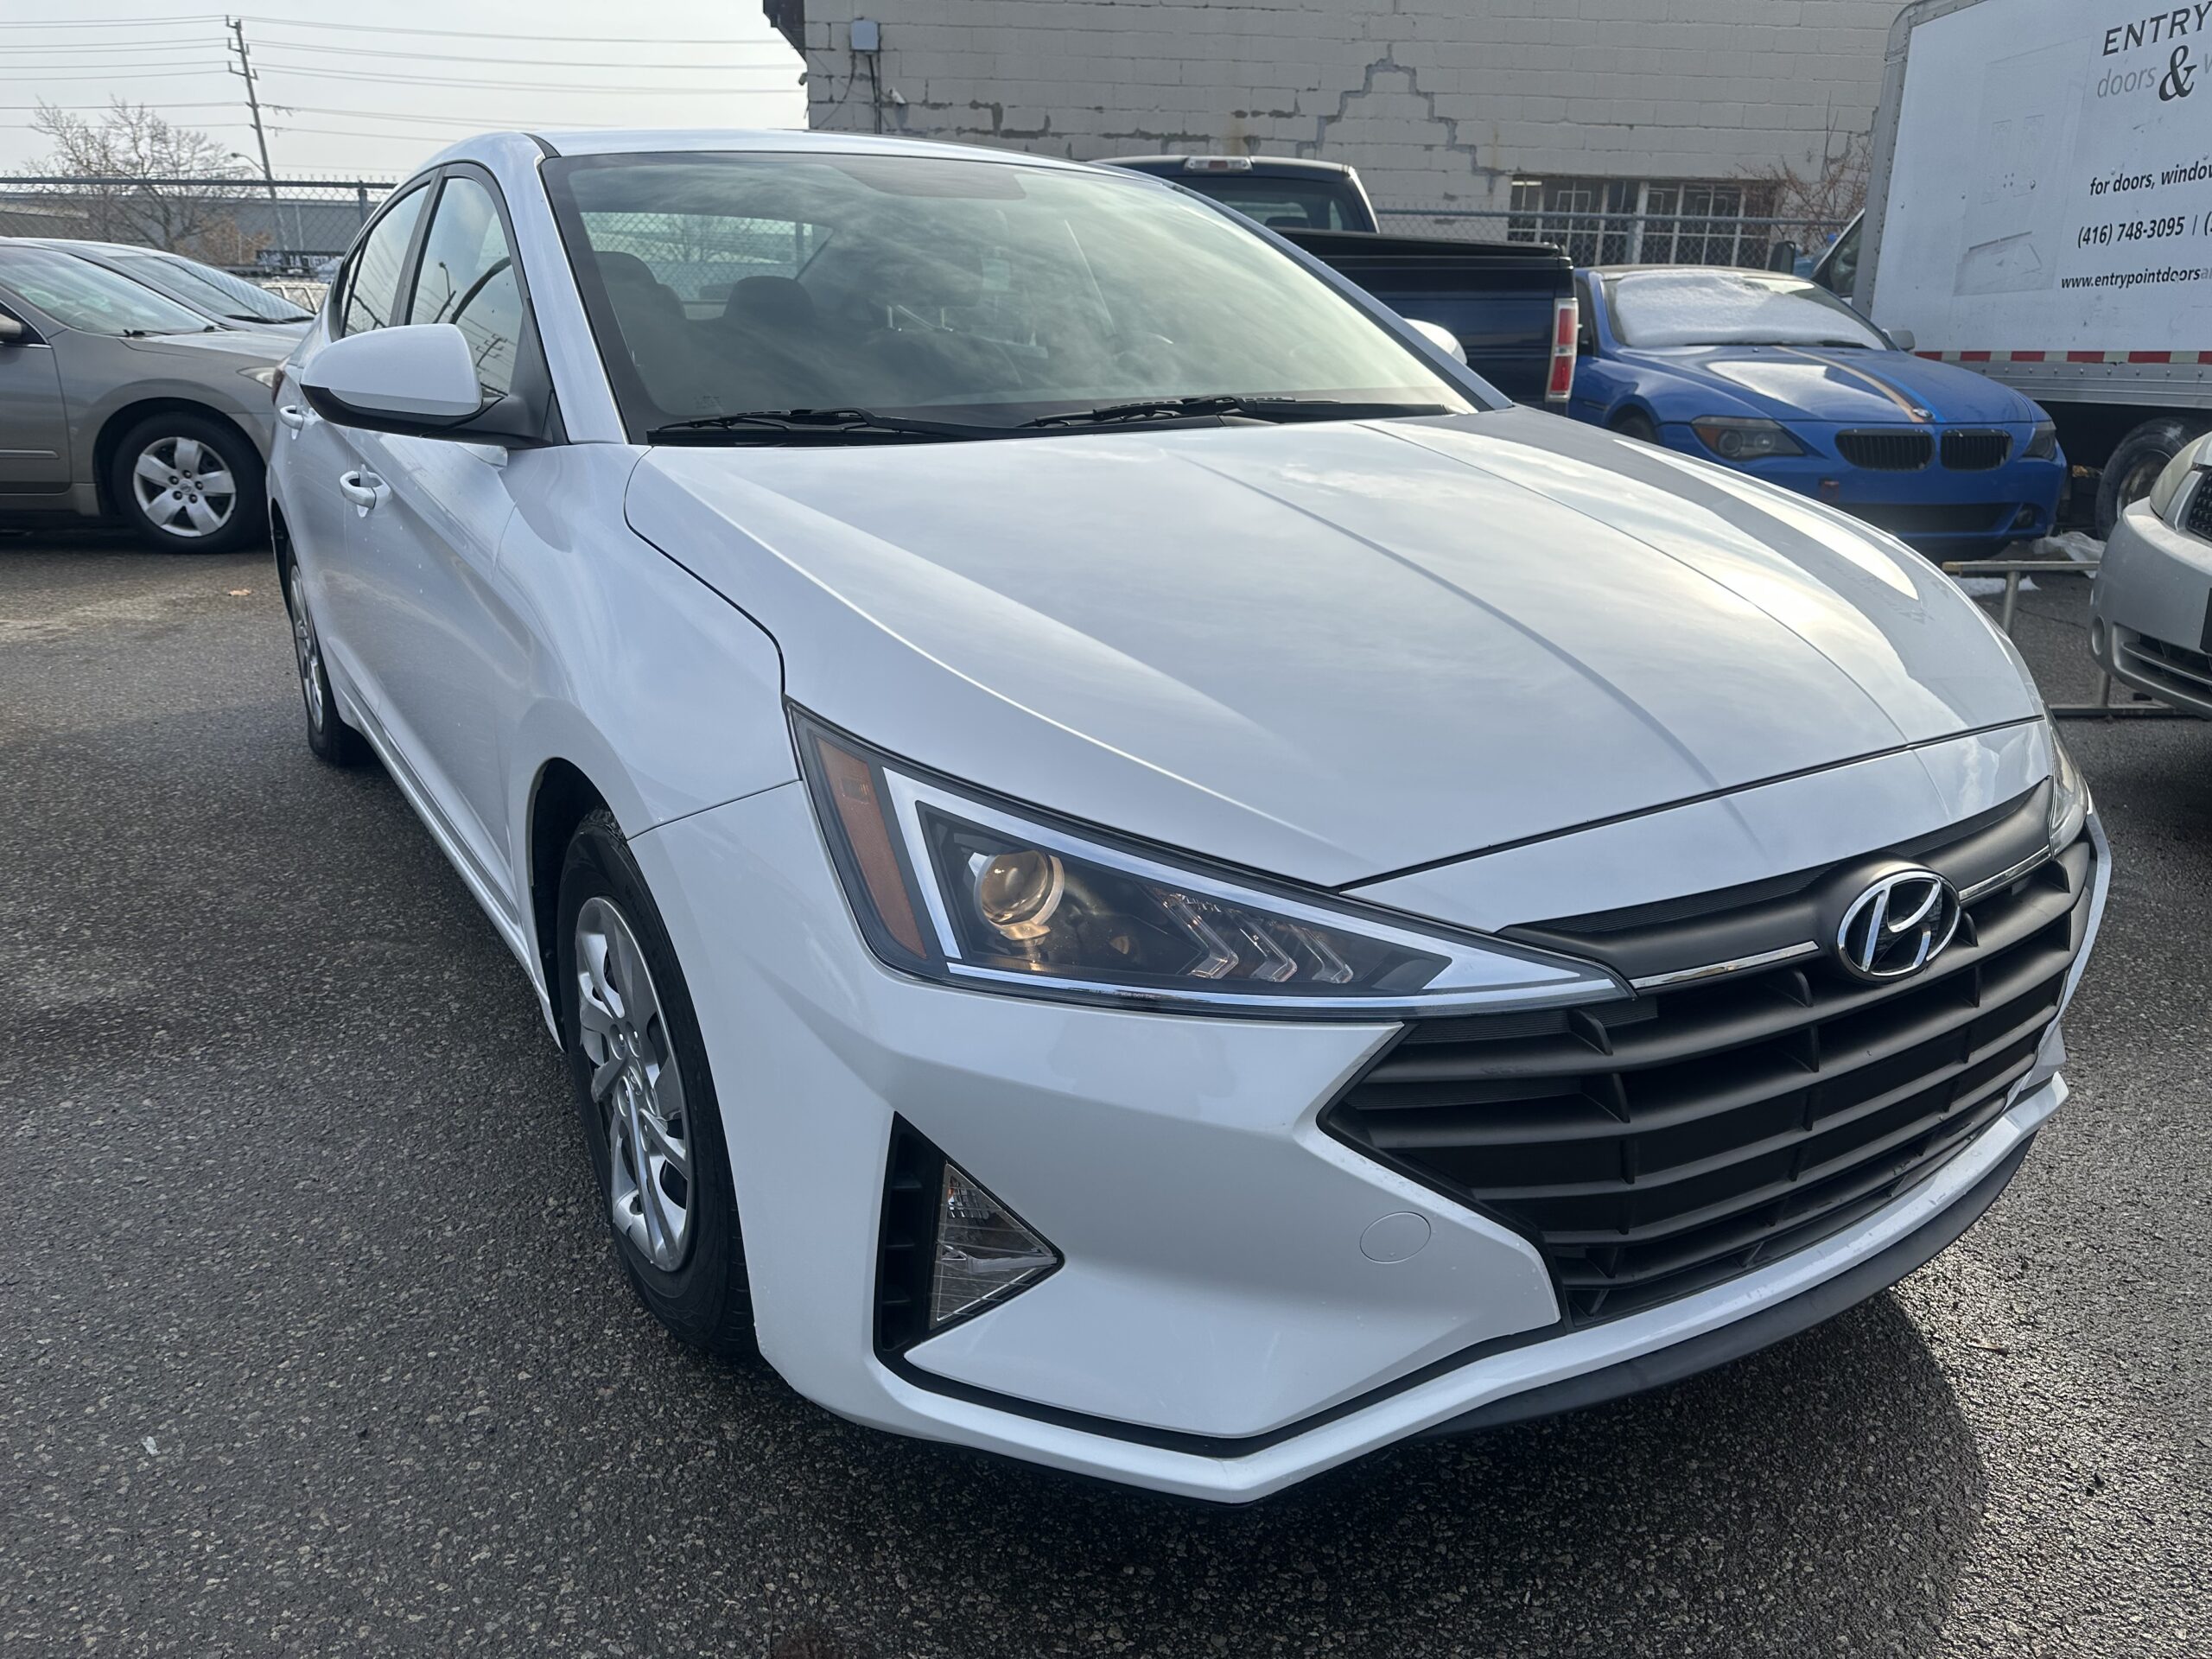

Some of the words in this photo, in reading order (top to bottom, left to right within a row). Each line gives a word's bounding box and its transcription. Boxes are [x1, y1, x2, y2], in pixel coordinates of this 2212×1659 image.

[2101, 1, 2212, 56] ENTRY
[2097, 66, 2157, 99] doors
[2158, 44, 2197, 102] &
[2089, 176, 2110, 195] for
[2113, 172, 2155, 192] doors,
[2161, 161, 2212, 185] windo
[2077, 223, 2113, 248] (416)
[2117, 216, 2185, 241] 748-3095
